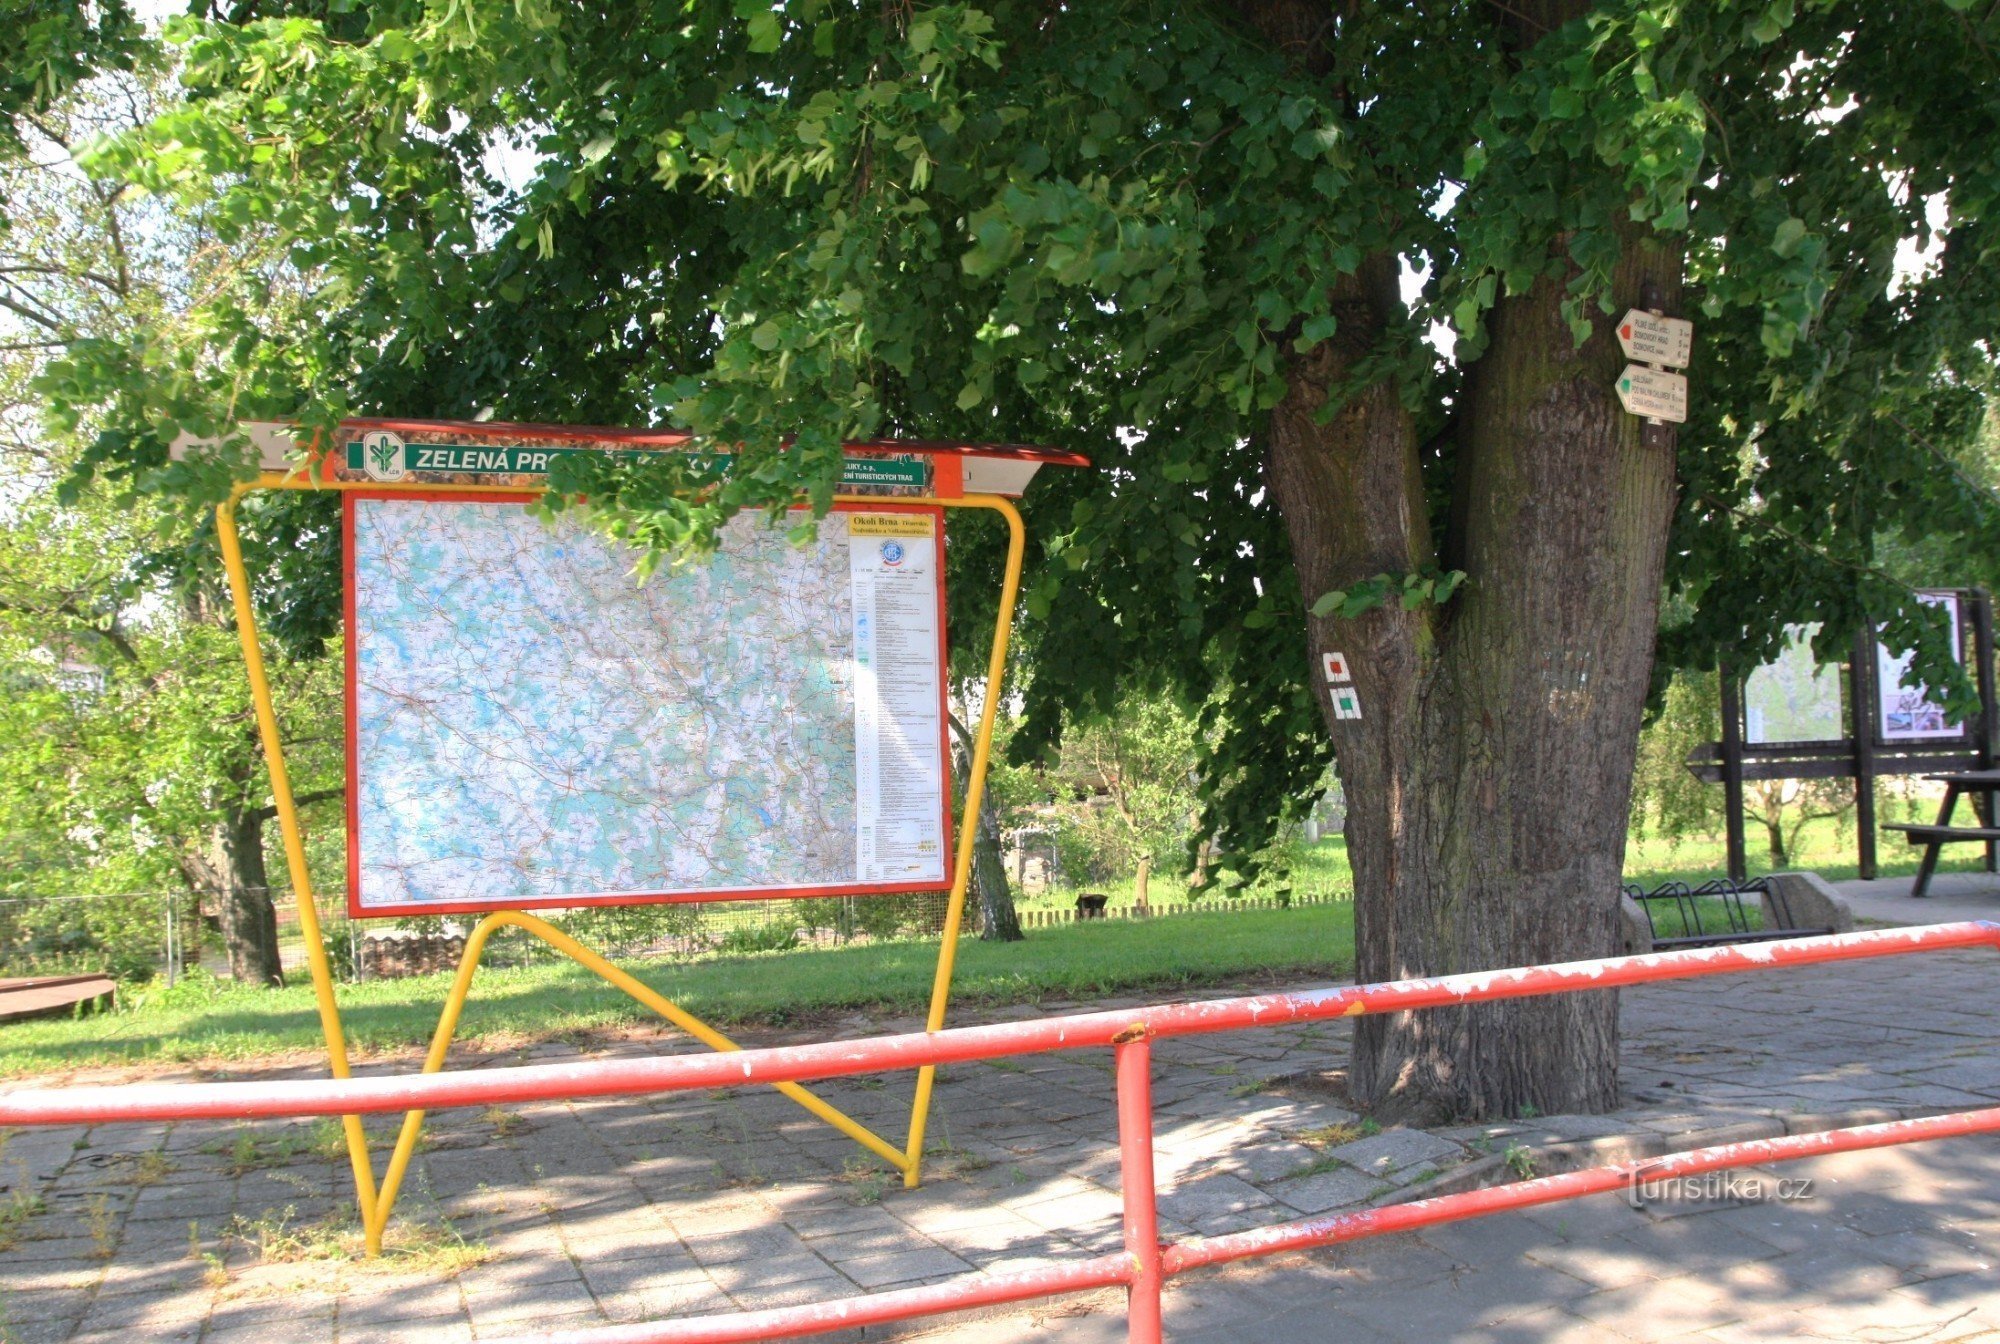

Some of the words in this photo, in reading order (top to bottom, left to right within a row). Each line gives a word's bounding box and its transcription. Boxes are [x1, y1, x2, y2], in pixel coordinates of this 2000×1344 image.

[416, 447, 509, 470] ZELENÁ
[516, 452, 561, 471] PR
[855, 472, 897, 481] TURISTICKÝCH
[897, 474, 913, 482] TRAS
[854, 517, 876, 525] Okolí
[878, 517, 898, 526] Brna
